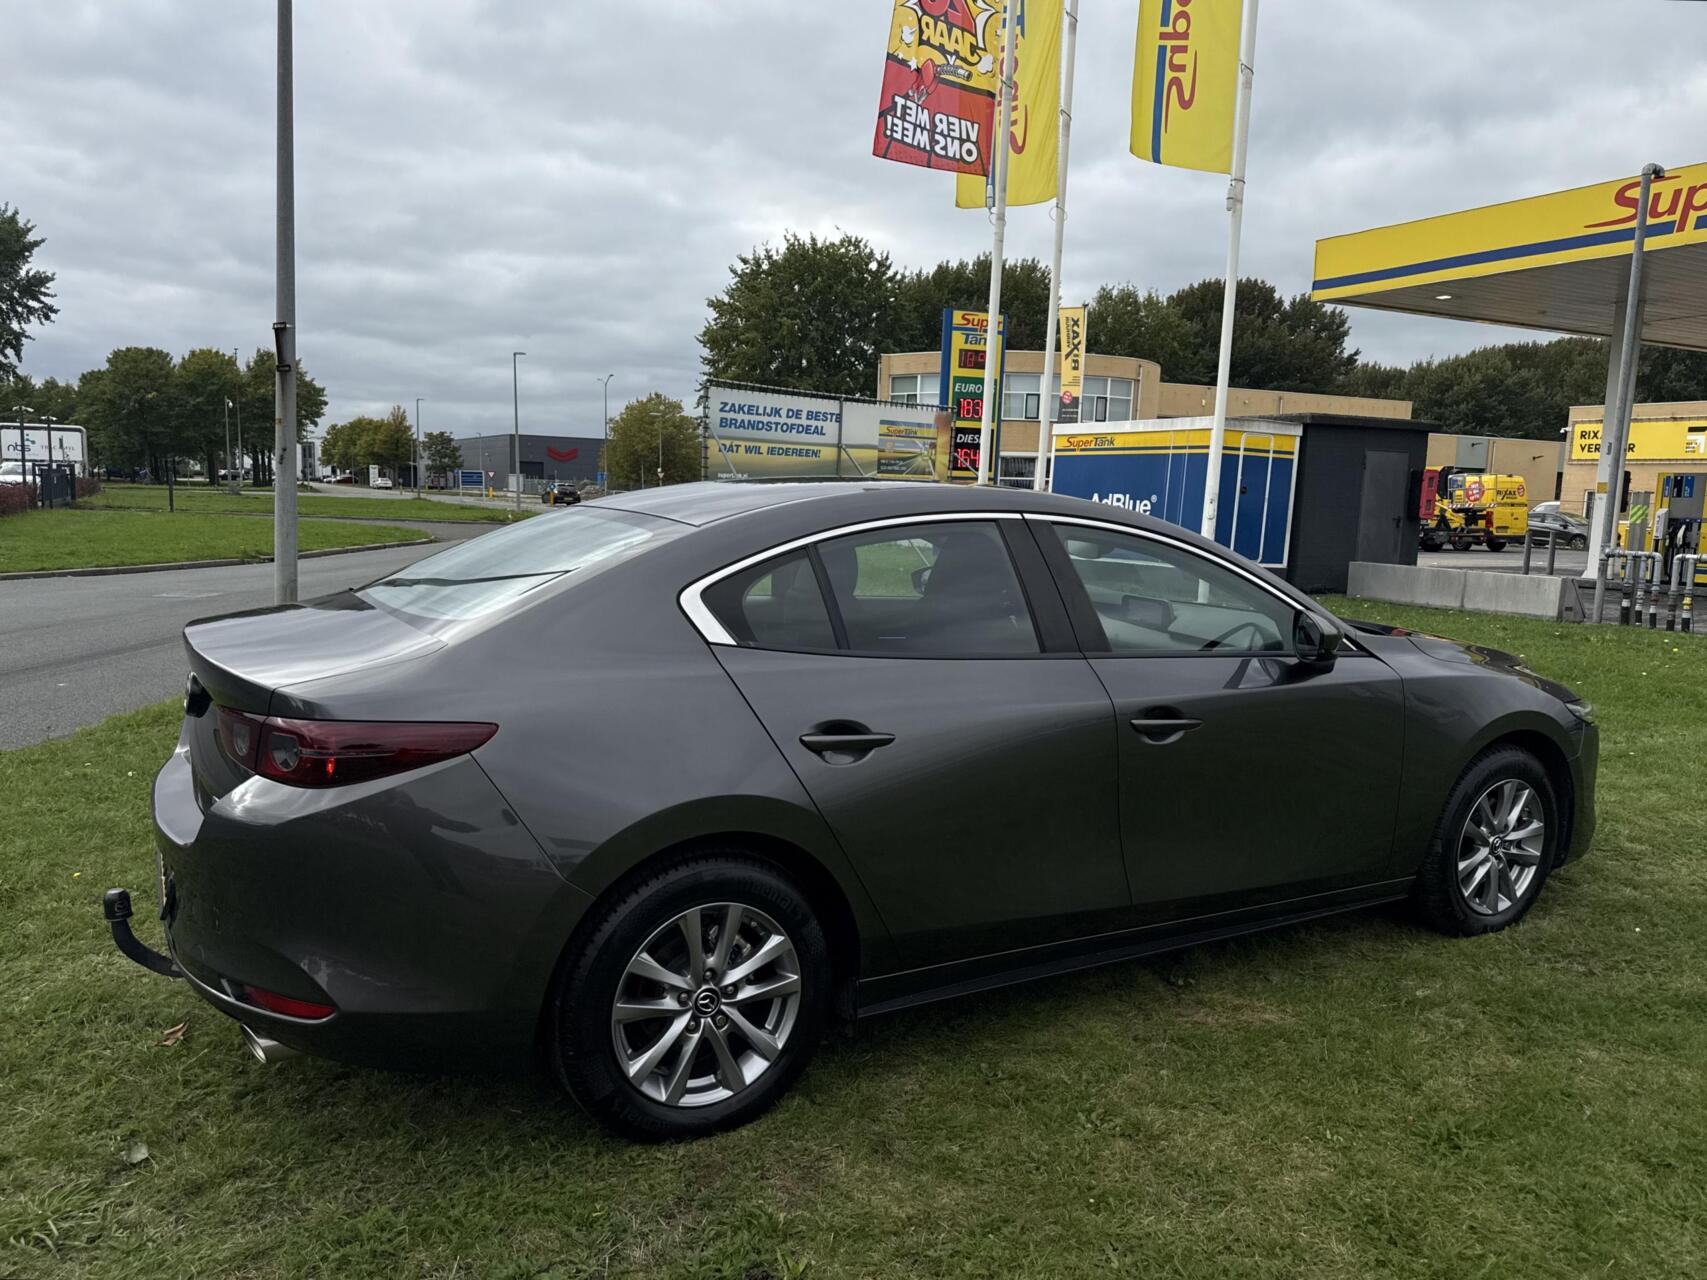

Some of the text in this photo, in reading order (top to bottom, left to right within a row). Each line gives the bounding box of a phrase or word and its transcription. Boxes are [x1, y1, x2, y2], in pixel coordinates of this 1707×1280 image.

[955, 313, 1003, 331] Supr
[961, 333, 987, 346] Tan
[954, 383, 982, 393] EURO
[719, 401, 841, 423] ZAKELIJK DE BESTE
[719, 417, 826, 436] BRANDSTOFDEAL
[1063, 436, 1116, 450] SuperTank
[744, 445, 763, 455] WIL
[767, 446, 821, 458] IEDEREEN!
